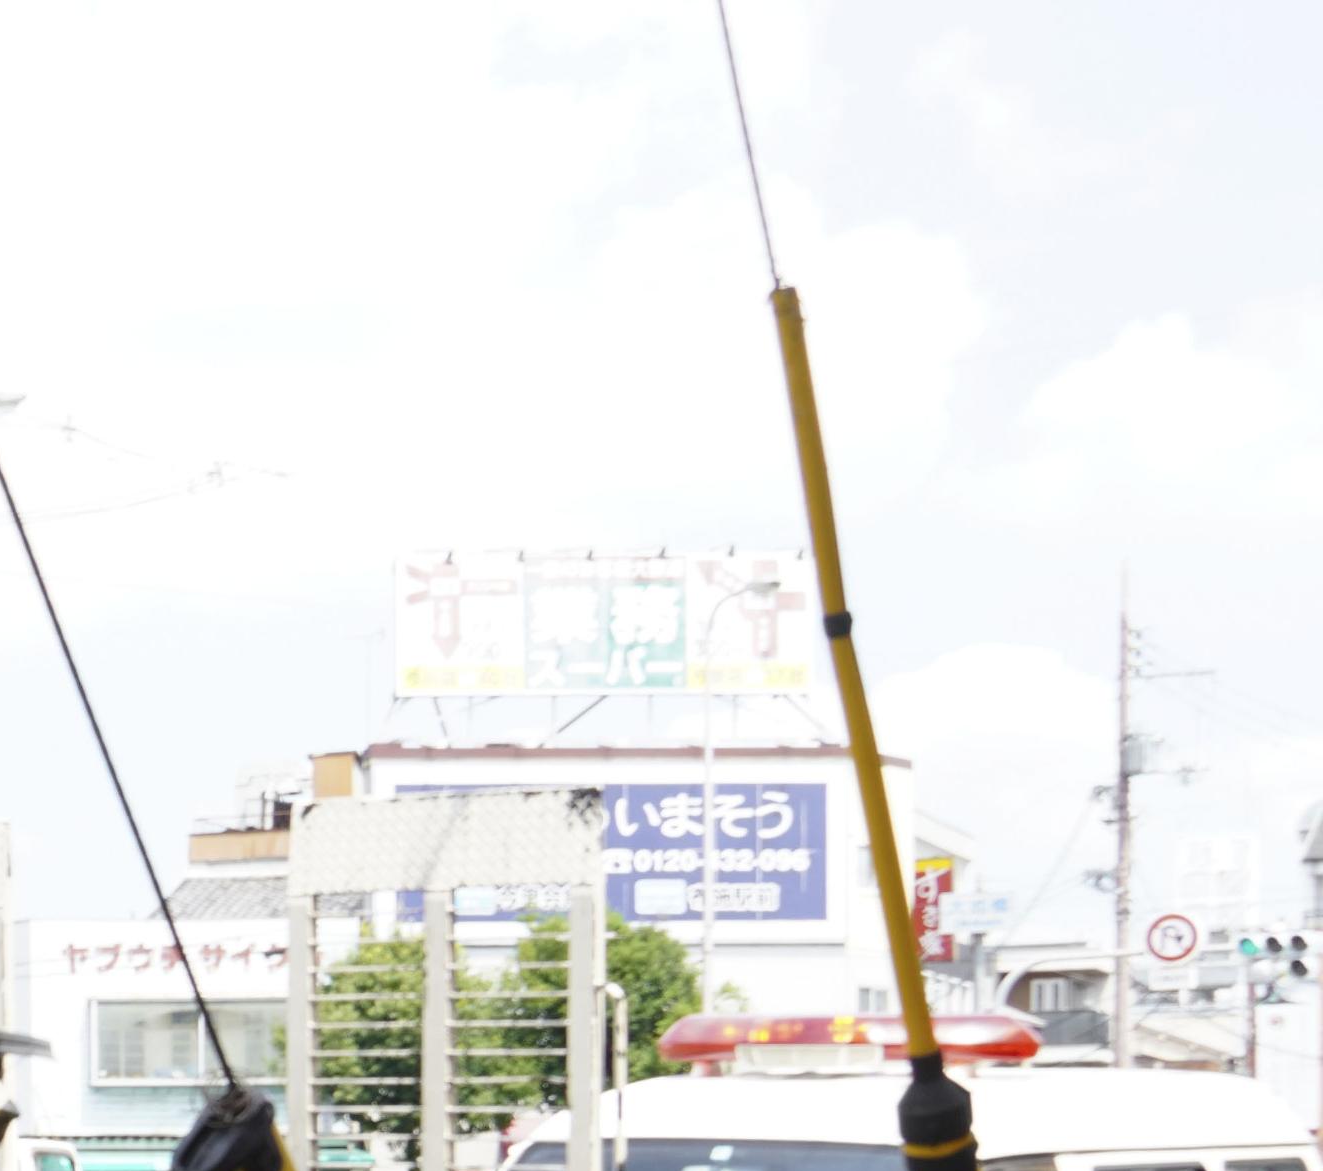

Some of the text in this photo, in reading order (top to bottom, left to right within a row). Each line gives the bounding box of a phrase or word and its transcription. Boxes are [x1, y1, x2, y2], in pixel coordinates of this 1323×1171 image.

[528, 646, 685, 686] スーパー
[602, 791, 795, 839] いまそう
